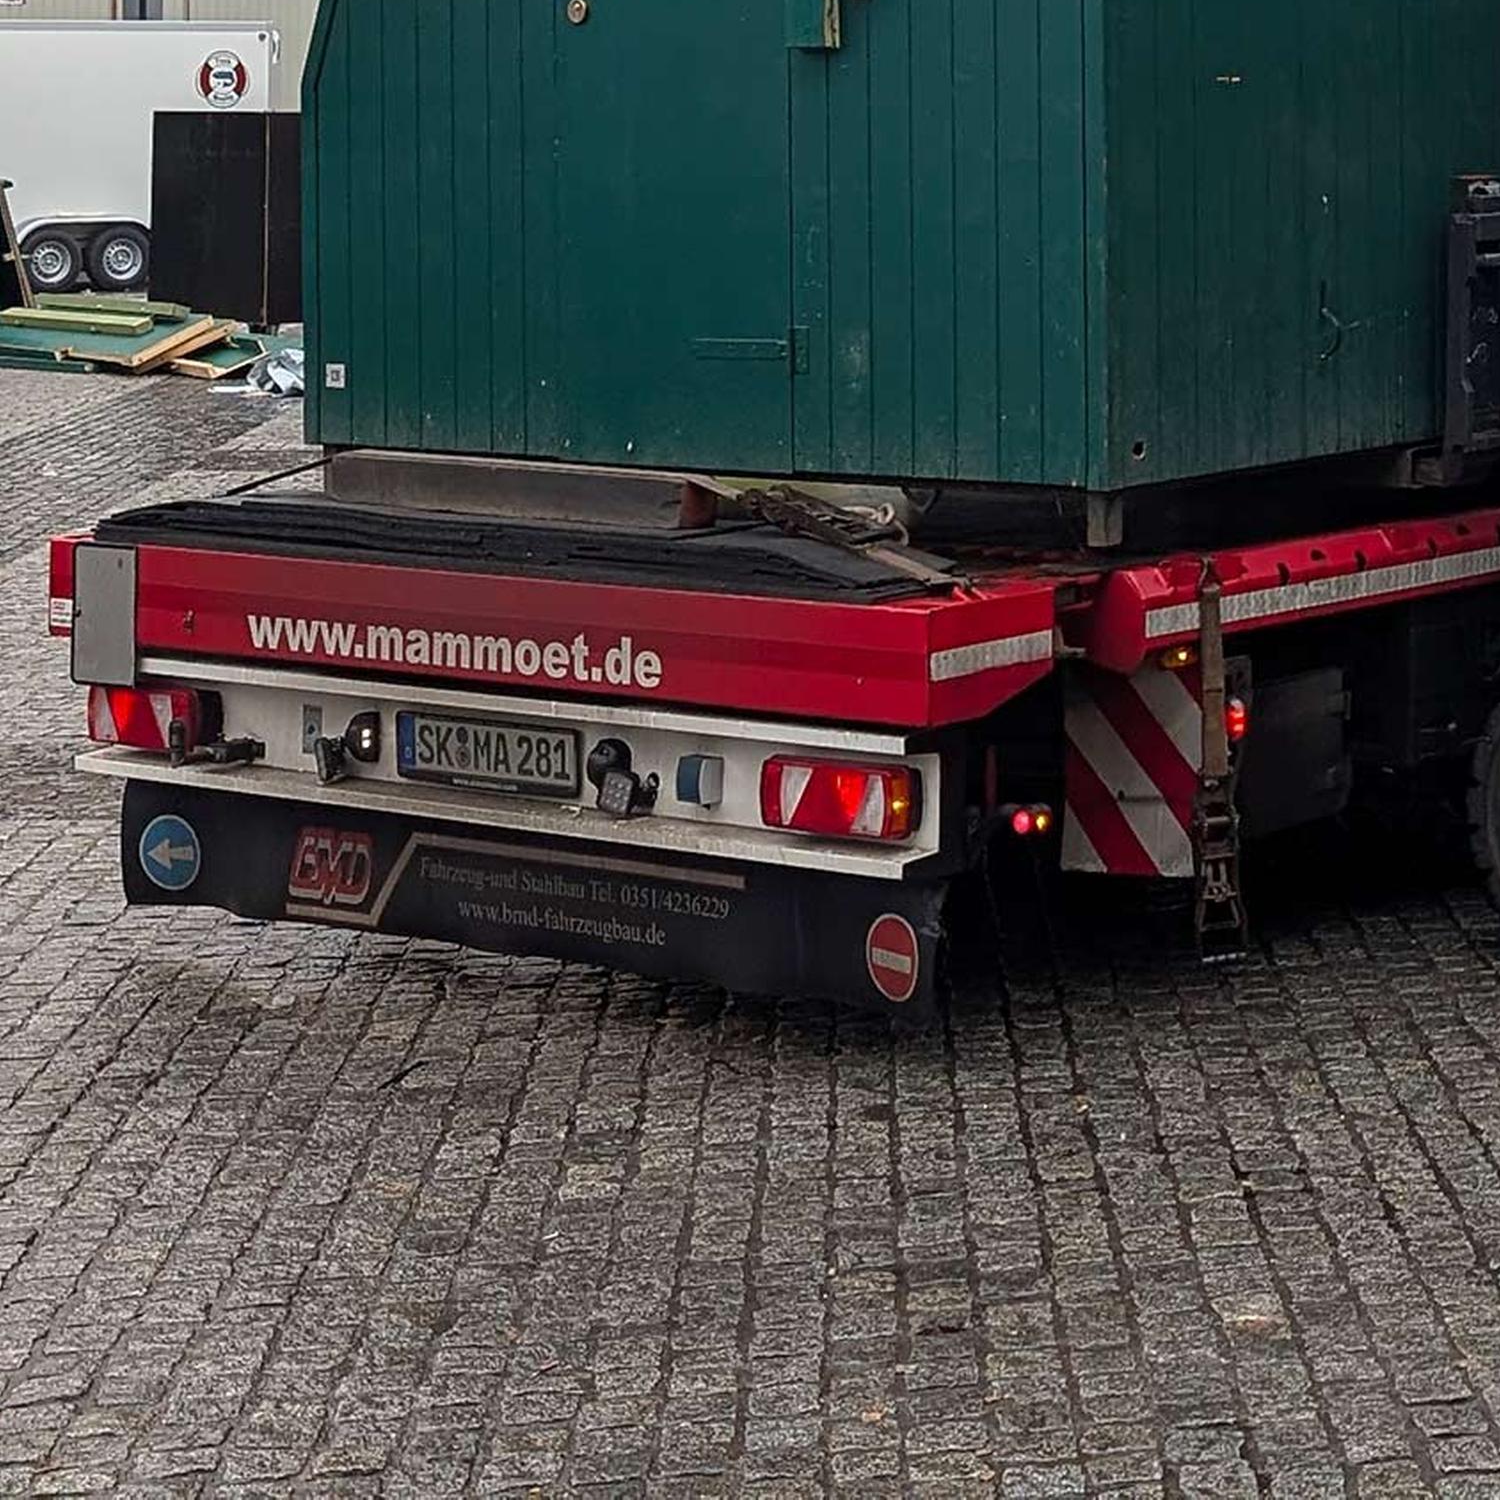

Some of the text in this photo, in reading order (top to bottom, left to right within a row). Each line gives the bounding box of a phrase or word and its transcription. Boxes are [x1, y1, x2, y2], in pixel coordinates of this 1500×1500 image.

[247, 614, 662, 688] www.mammoet.de
[418, 725, 571, 781] SK MA 281
